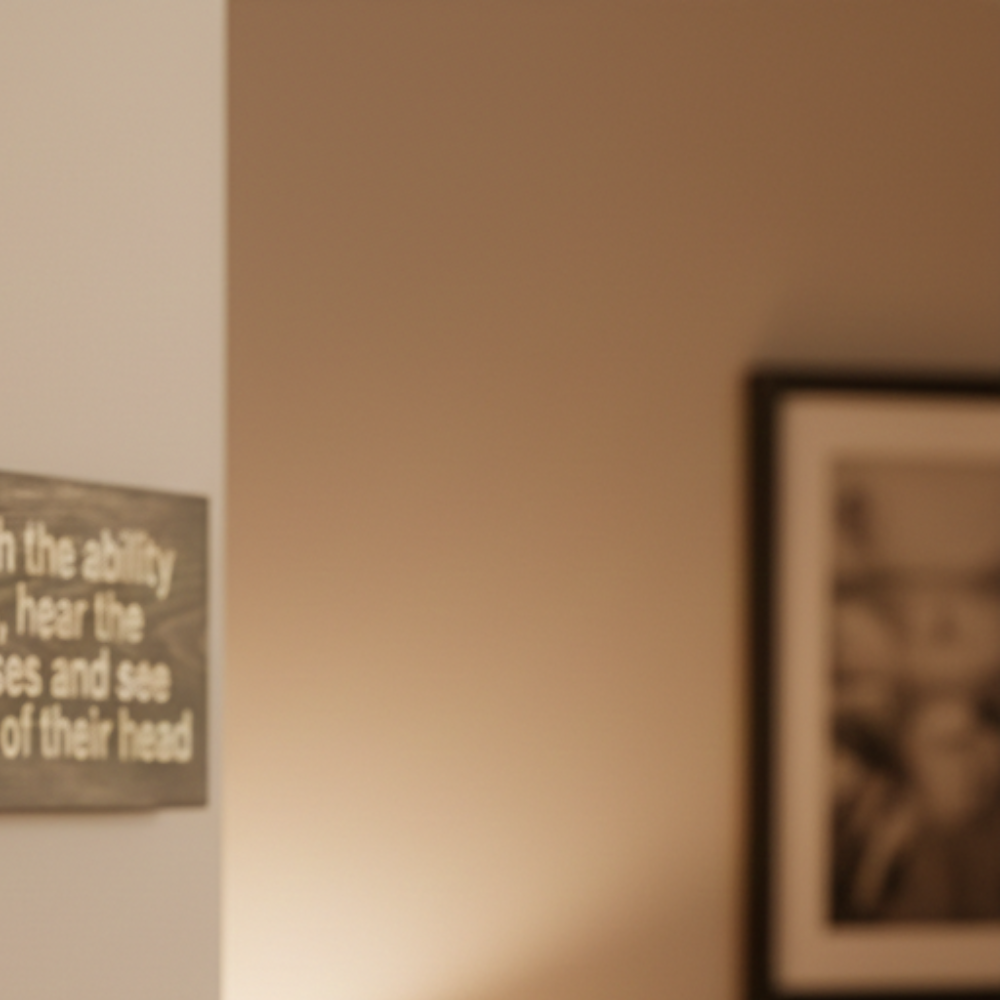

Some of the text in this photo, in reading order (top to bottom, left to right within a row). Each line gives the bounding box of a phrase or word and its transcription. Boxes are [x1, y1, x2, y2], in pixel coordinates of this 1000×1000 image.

[24, 520, 77, 580] the
[16, 582, 88, 640] hear
[93, 590, 145, 644] the
[50, 647, 110, 700] and
[116, 661, 171, 703] see
[0, 702, 34, 759] of
[38, 705, 114, 761] their
[118, 707, 194, 763] head
